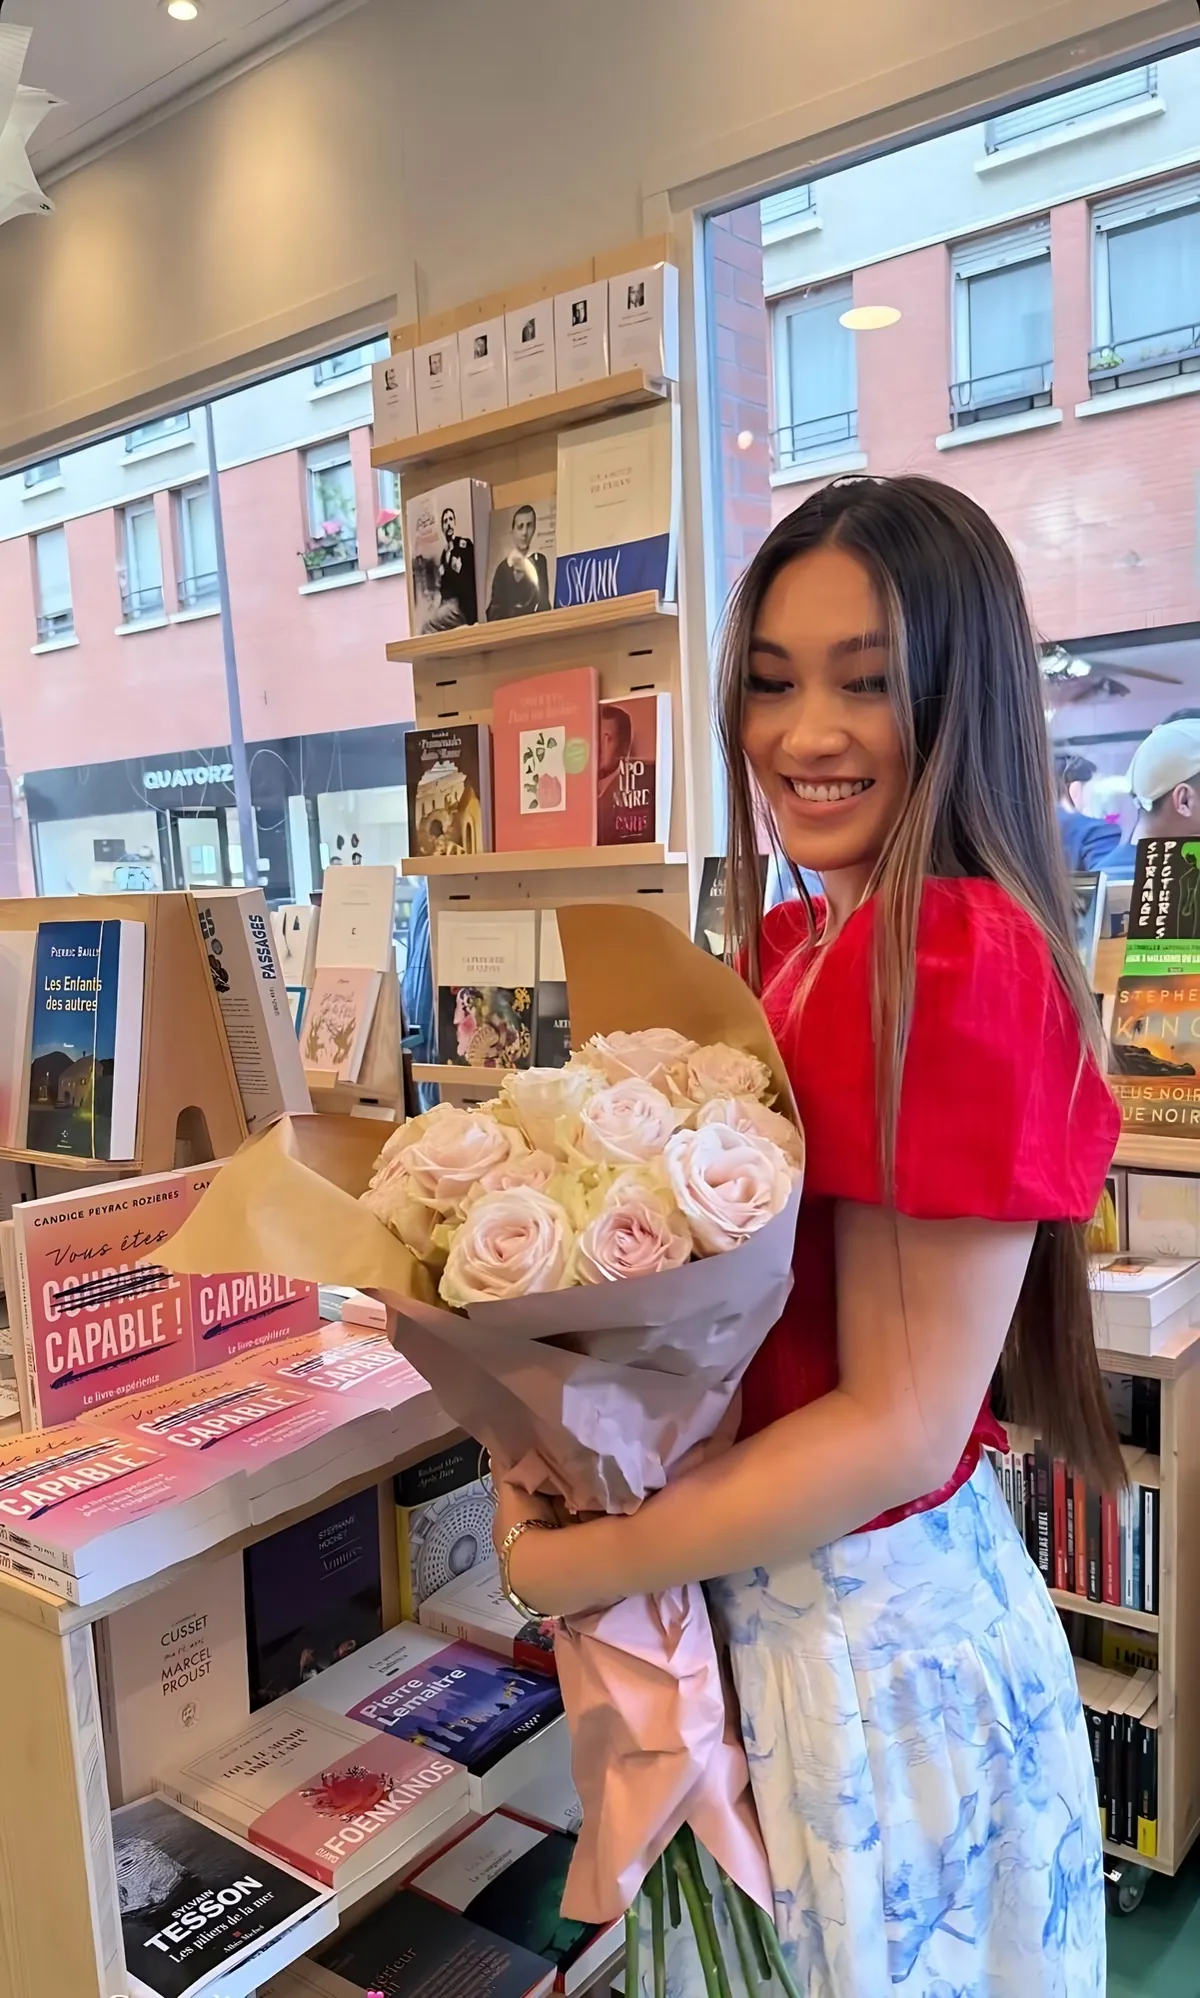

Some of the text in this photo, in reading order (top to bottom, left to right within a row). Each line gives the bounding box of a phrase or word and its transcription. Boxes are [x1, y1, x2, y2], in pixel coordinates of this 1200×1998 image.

[144, 764, 234, 789] QUATORZ
[1138, 841, 1158, 926] STRANGE
[1155, 841, 1177, 939] PICTURES
[249, 914, 277, 980] PASSAGES
[44, 976, 102, 992] Les Enfants
[46, 995, 98, 1012] des autres
[1120, 988, 1200, 1004] STEPHE
[1112, 1085, 1154, 1100] LUS
[1122, 1107, 1200, 1125] UE NOIR
[34, 1210, 85, 1227] CANDICE
[88, 1200, 129, 1217] PEYRAC
[45, 1228, 169, 1267] Vous êtes
[46, 1297, 184, 1374] CAPABLE !
[308, 1349, 403, 1388] CAPABL
[83, 1395, 94, 1406] Le
[167, 1390, 298, 1448] CAPABLE
[0, 1453, 149, 1517] CAPABLE
[161, 1614, 208, 1646] CUSSET
[161, 1647, 212, 1681] MARCEL
[163, 1661, 212, 1696] PROUST
[360, 1678, 424, 1719] Pierre
[323, 1760, 455, 1856] FOENKINOS
[143, 1875, 263, 1952] TESSON
[171, 1889, 215, 1919] SYLVAIN
[169, 1891, 275, 1963] Les piliers de la mer
[367, 1947, 417, 1992] térieur
